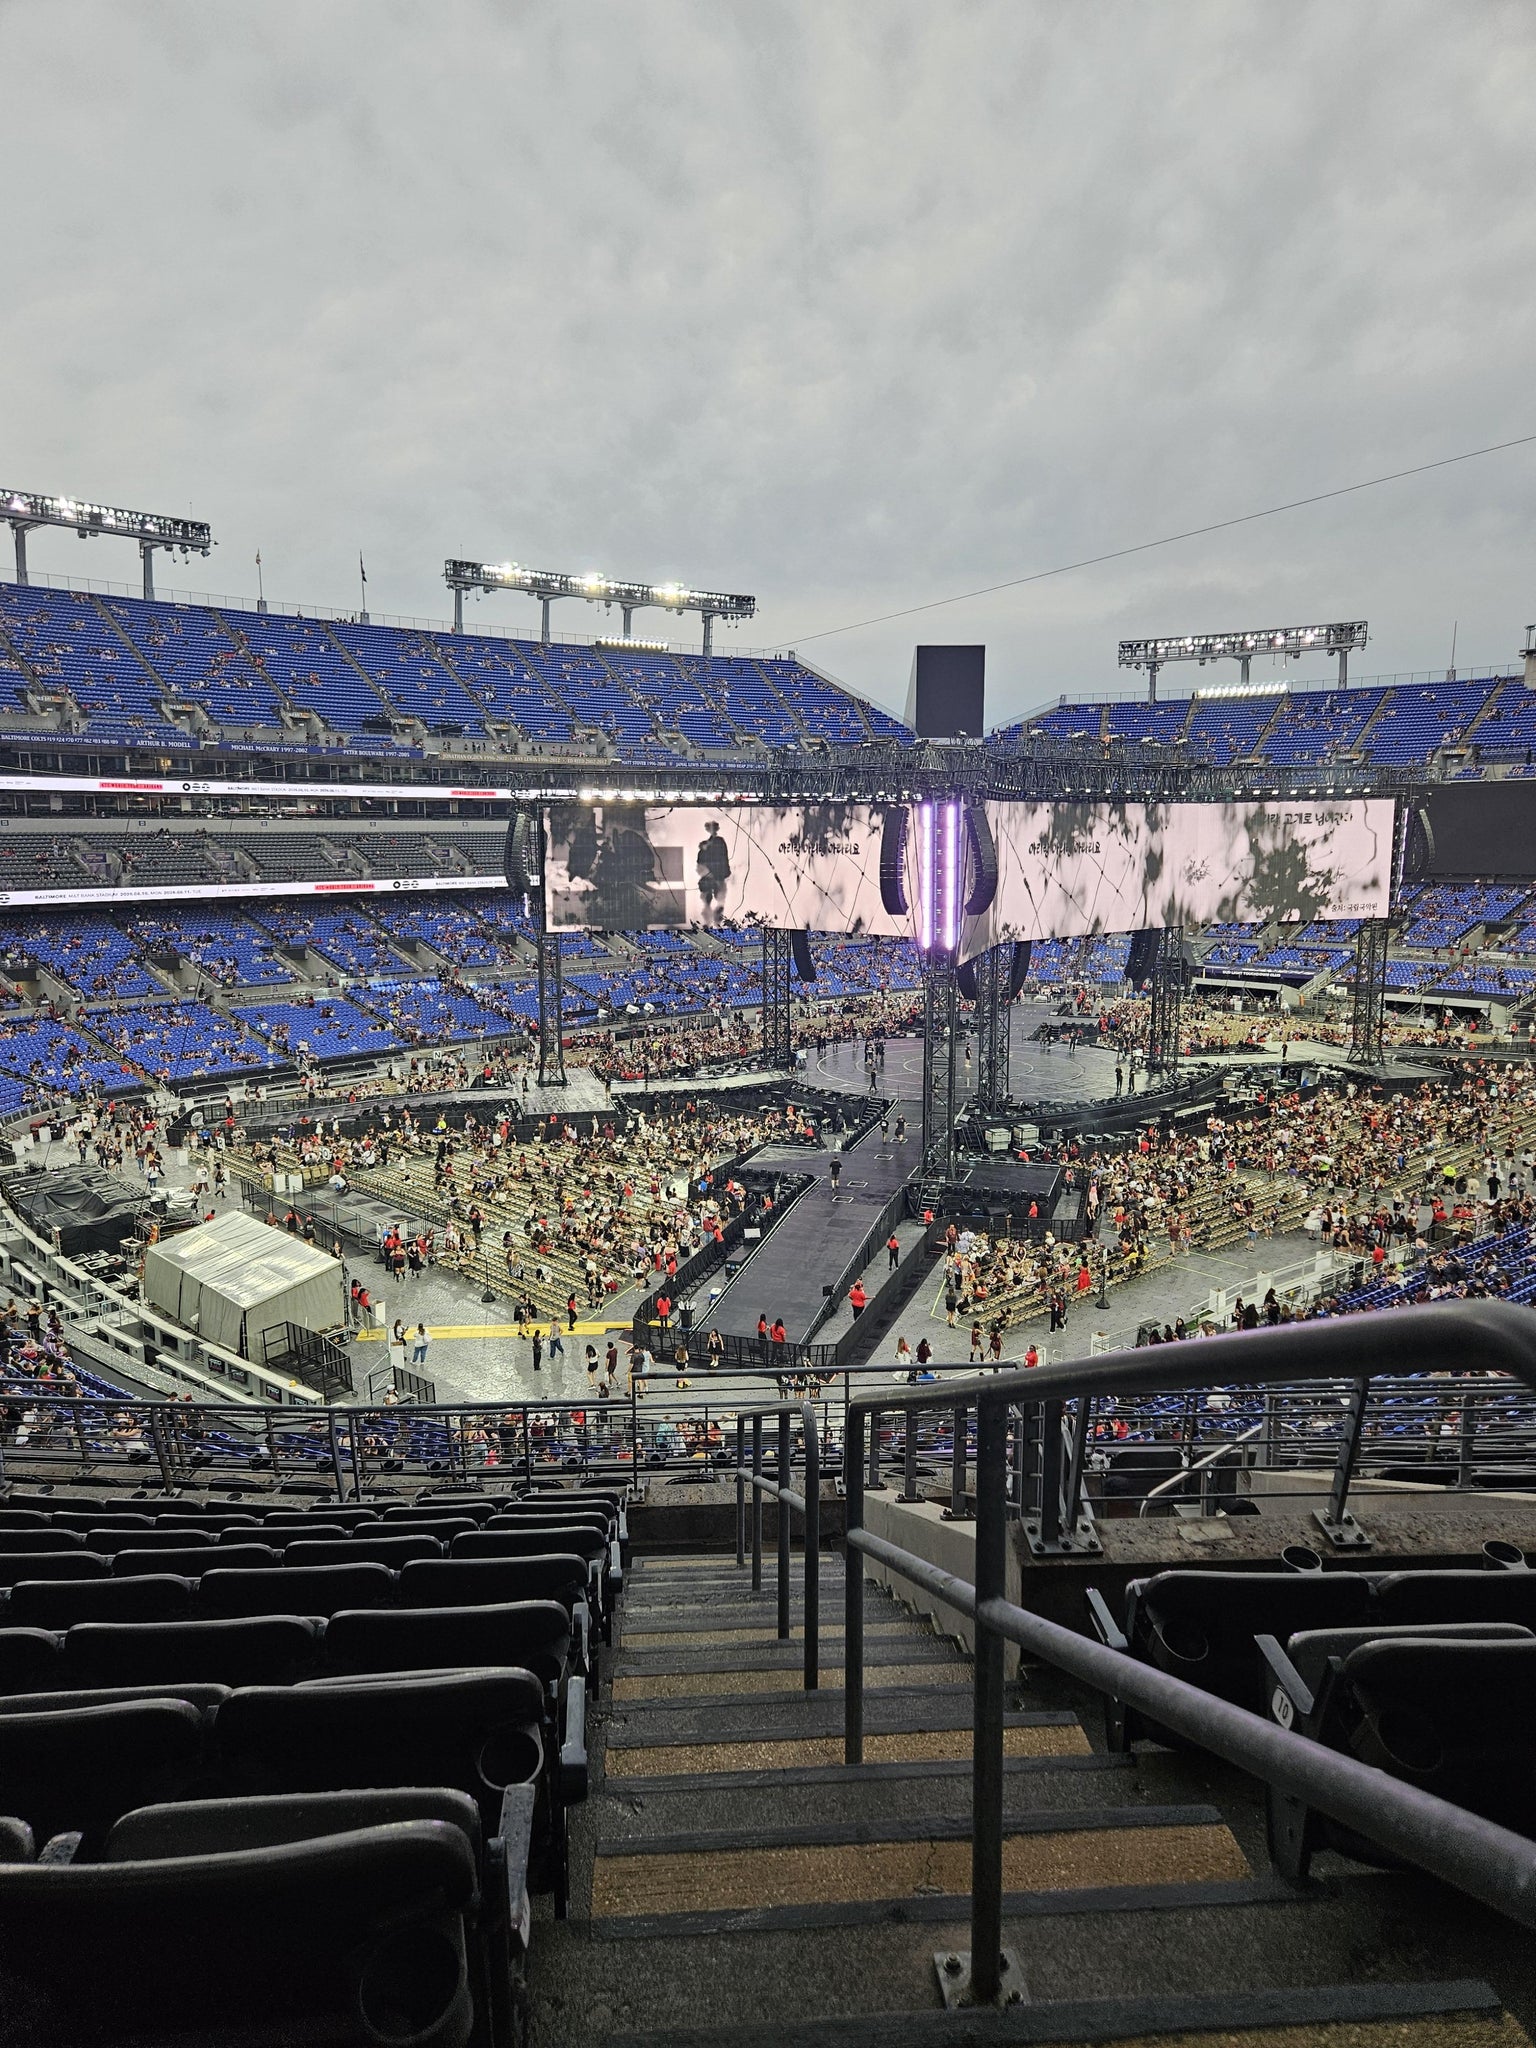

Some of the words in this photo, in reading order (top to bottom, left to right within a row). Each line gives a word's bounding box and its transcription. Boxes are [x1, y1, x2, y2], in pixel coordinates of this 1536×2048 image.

[778, 842, 800, 857] 아리랑
[828, 842, 860, 855] 아라리요
[1278, 1696, 1289, 1720] 10
